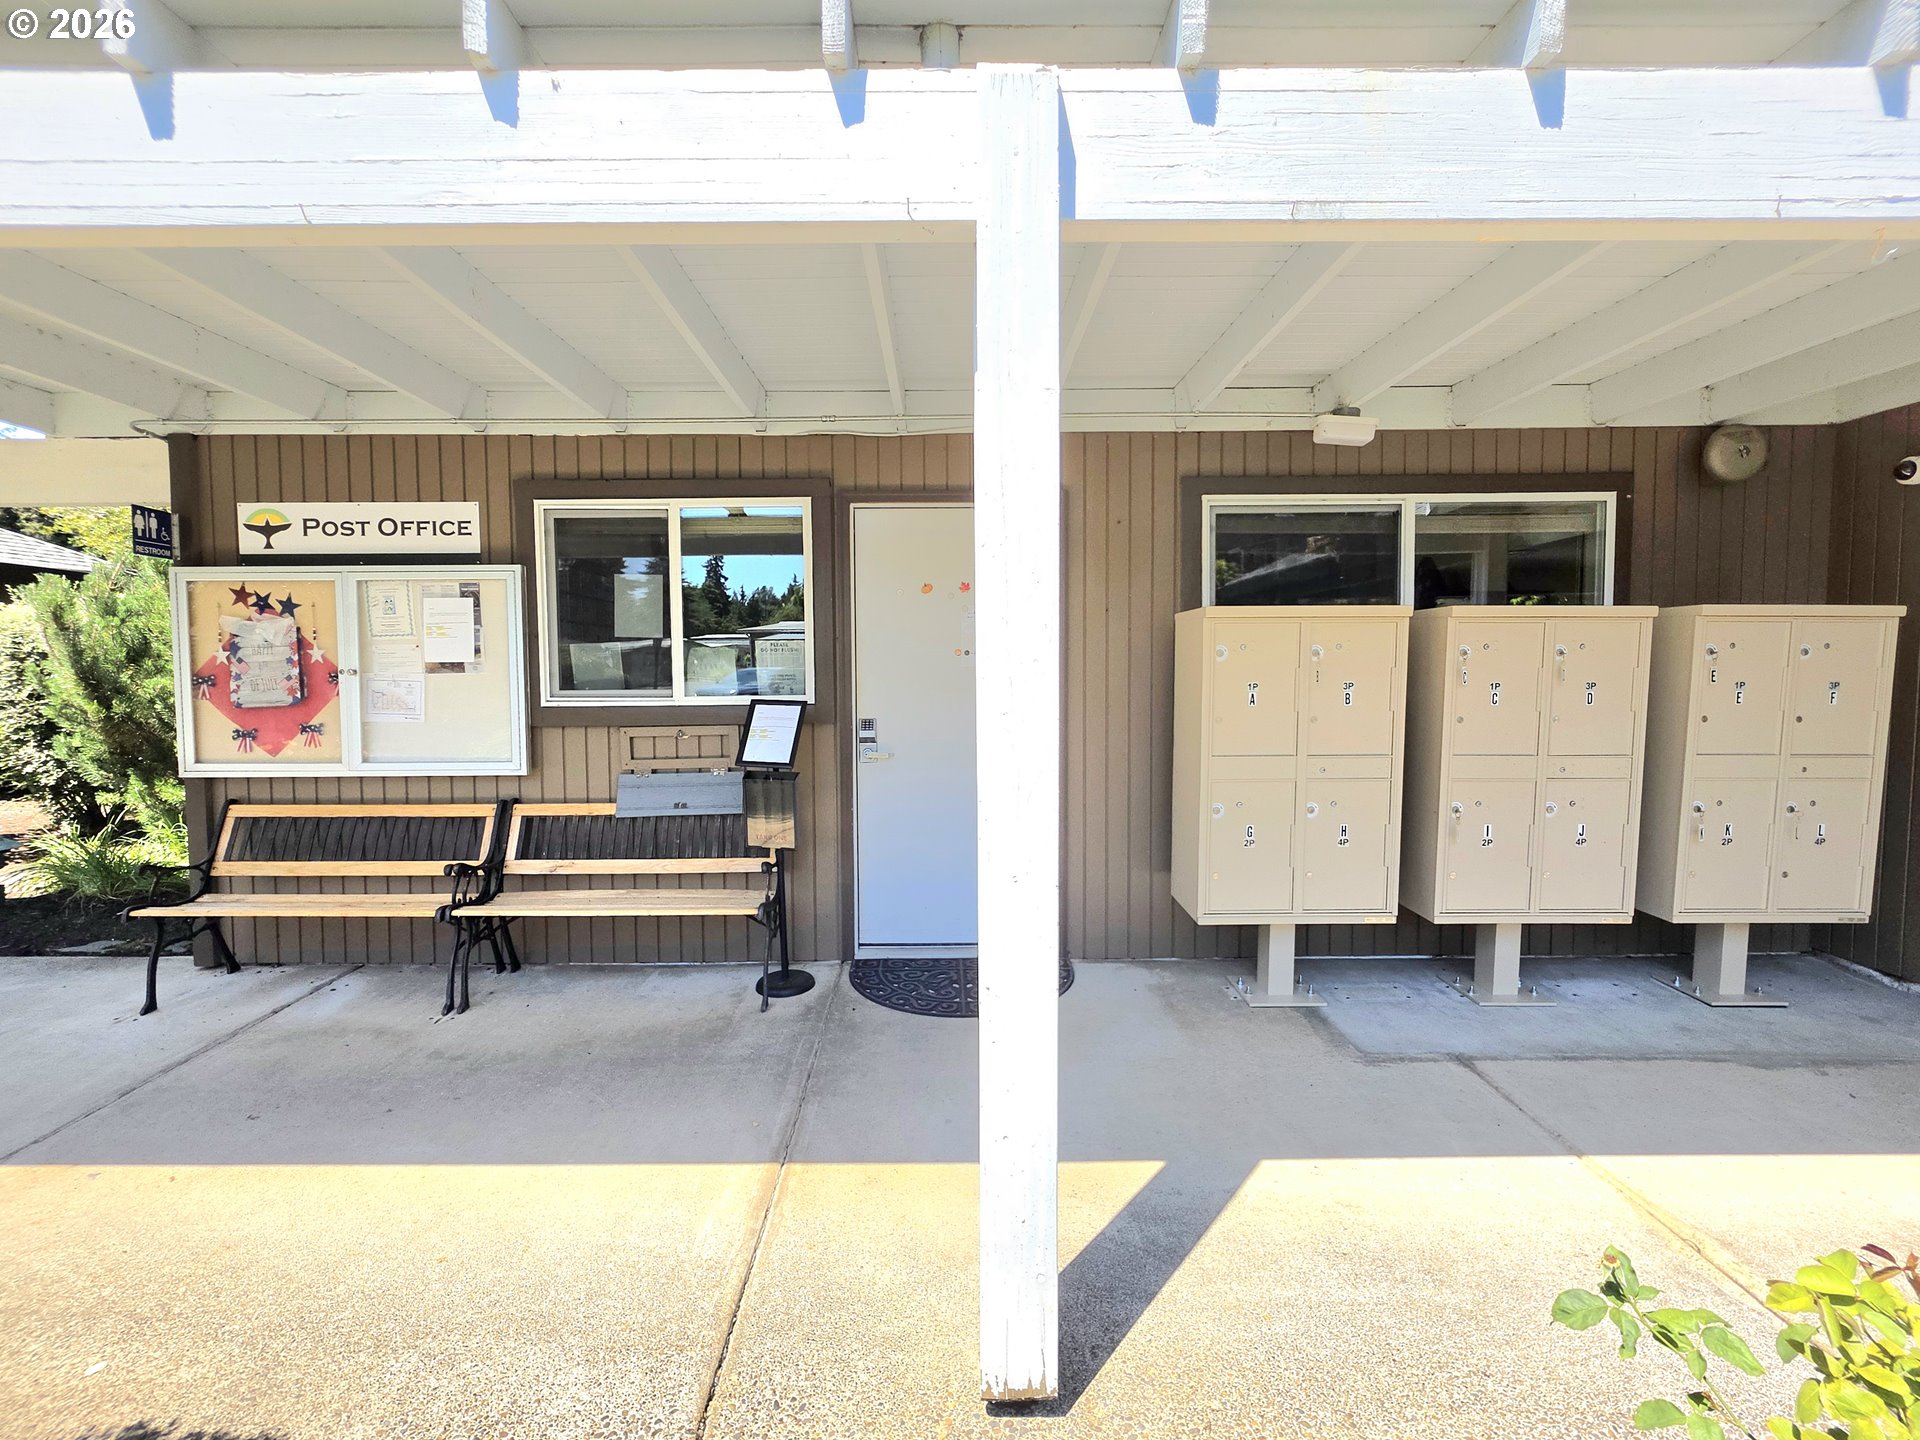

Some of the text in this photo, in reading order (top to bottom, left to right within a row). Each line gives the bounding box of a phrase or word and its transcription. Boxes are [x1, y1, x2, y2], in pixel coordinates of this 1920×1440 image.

[302, 517, 473, 537] POST OFFICE
[135, 545, 171, 557] RESTROOM
[1711, 670, 1716, 683] E
[1343, 682, 1354, 690] 3P
[1490, 682, 1501, 690] 1P
[1585, 682, 1597, 690] 3P
[1734, 681, 1746, 689] 1P
[1828, 681, 1840, 689] 3P
[1249, 693, 1256, 706] A
[1344, 692, 1351, 705] B
[1492, 692, 1498, 705] C
[1587, 692, 1593, 705] D
[1736, 691, 1742, 704] E
[1830, 691, 1836, 704] F
[1246, 825, 1253, 838] G
[1341, 825, 1347, 837] H
[1578, 824, 1585, 837] J
[1725, 824, 1731, 836] K
[1818, 824, 1823, 836] L
[1244, 839, 1255, 847] 2P
[1338, 838, 1349, 846] 4P
[1481, 838, 1493, 847] 2P
[1721, 838, 1733, 846] 2P
[1814, 837, 1826, 845] 4P
